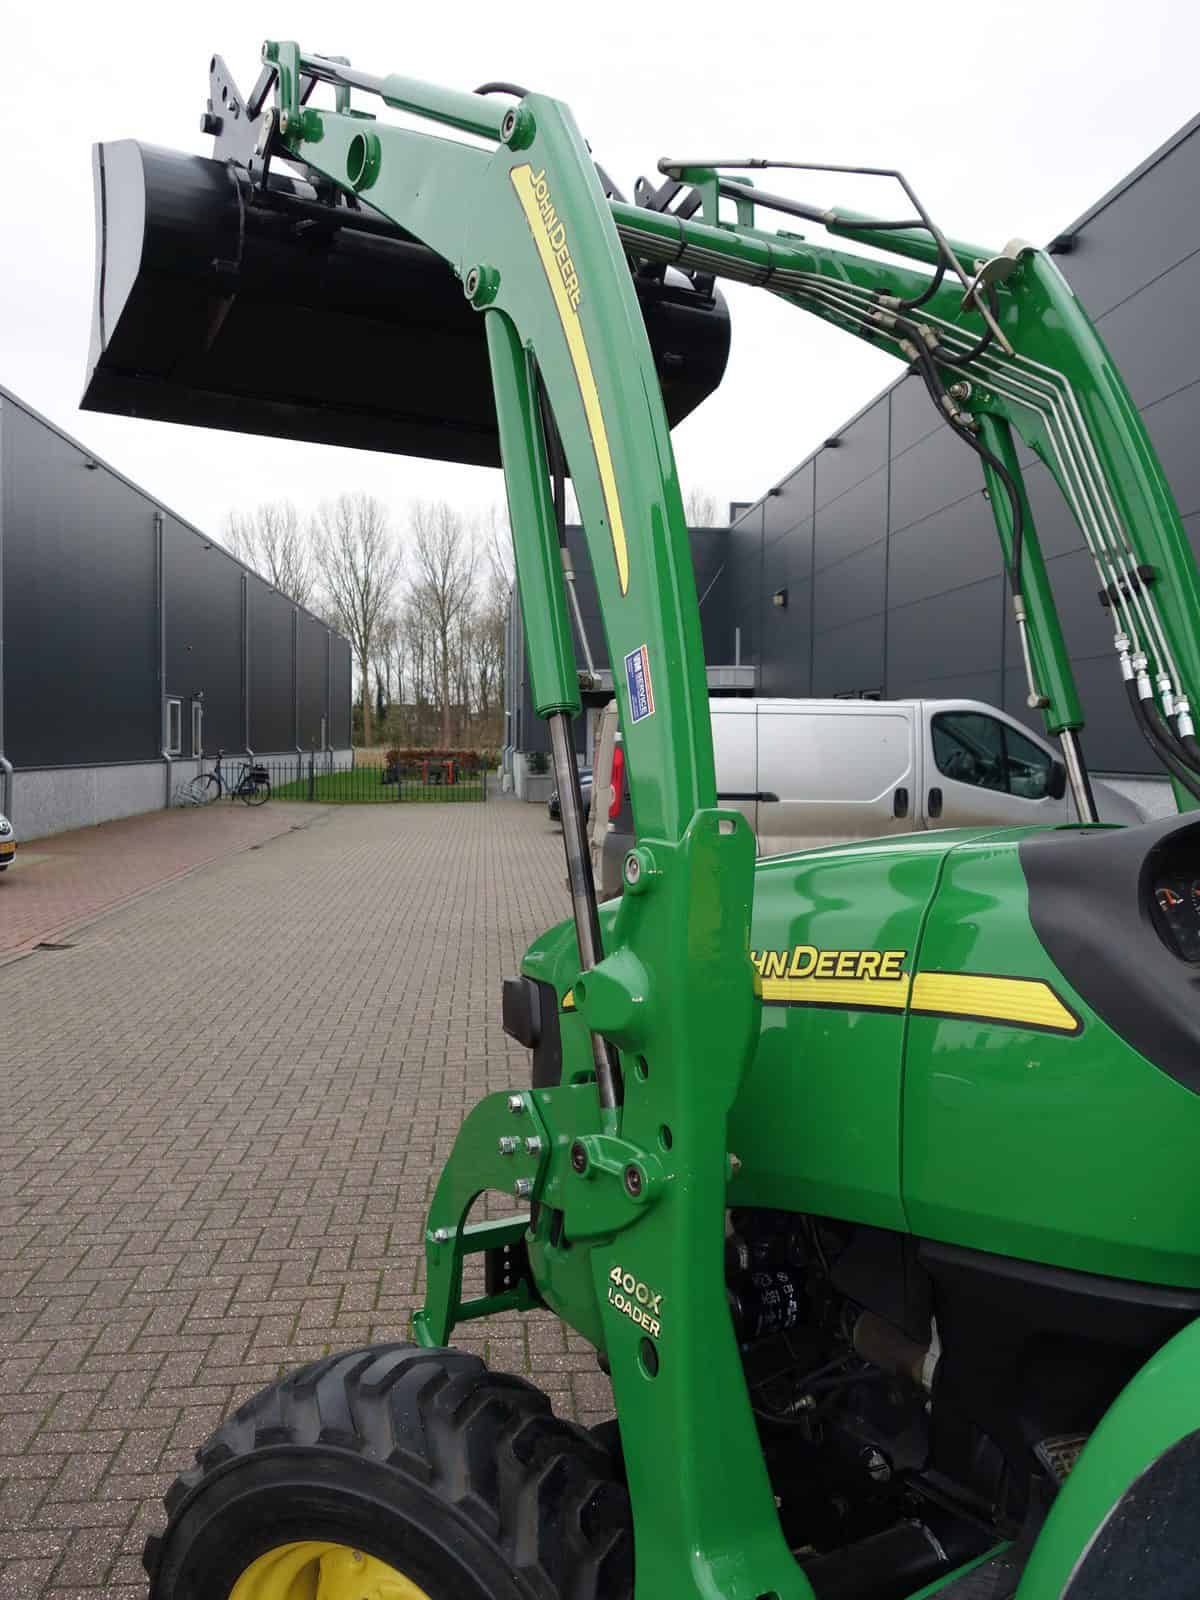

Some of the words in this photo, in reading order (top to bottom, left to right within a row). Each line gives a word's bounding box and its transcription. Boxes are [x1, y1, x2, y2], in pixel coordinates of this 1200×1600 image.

[530, 168, 558, 233] JOHN
[550, 222, 581, 312] DEERE
[788, 945, 906, 979] DEERE
[608, 1287, 661, 1338] LOADER
[609, 1265, 662, 1315] 400X
